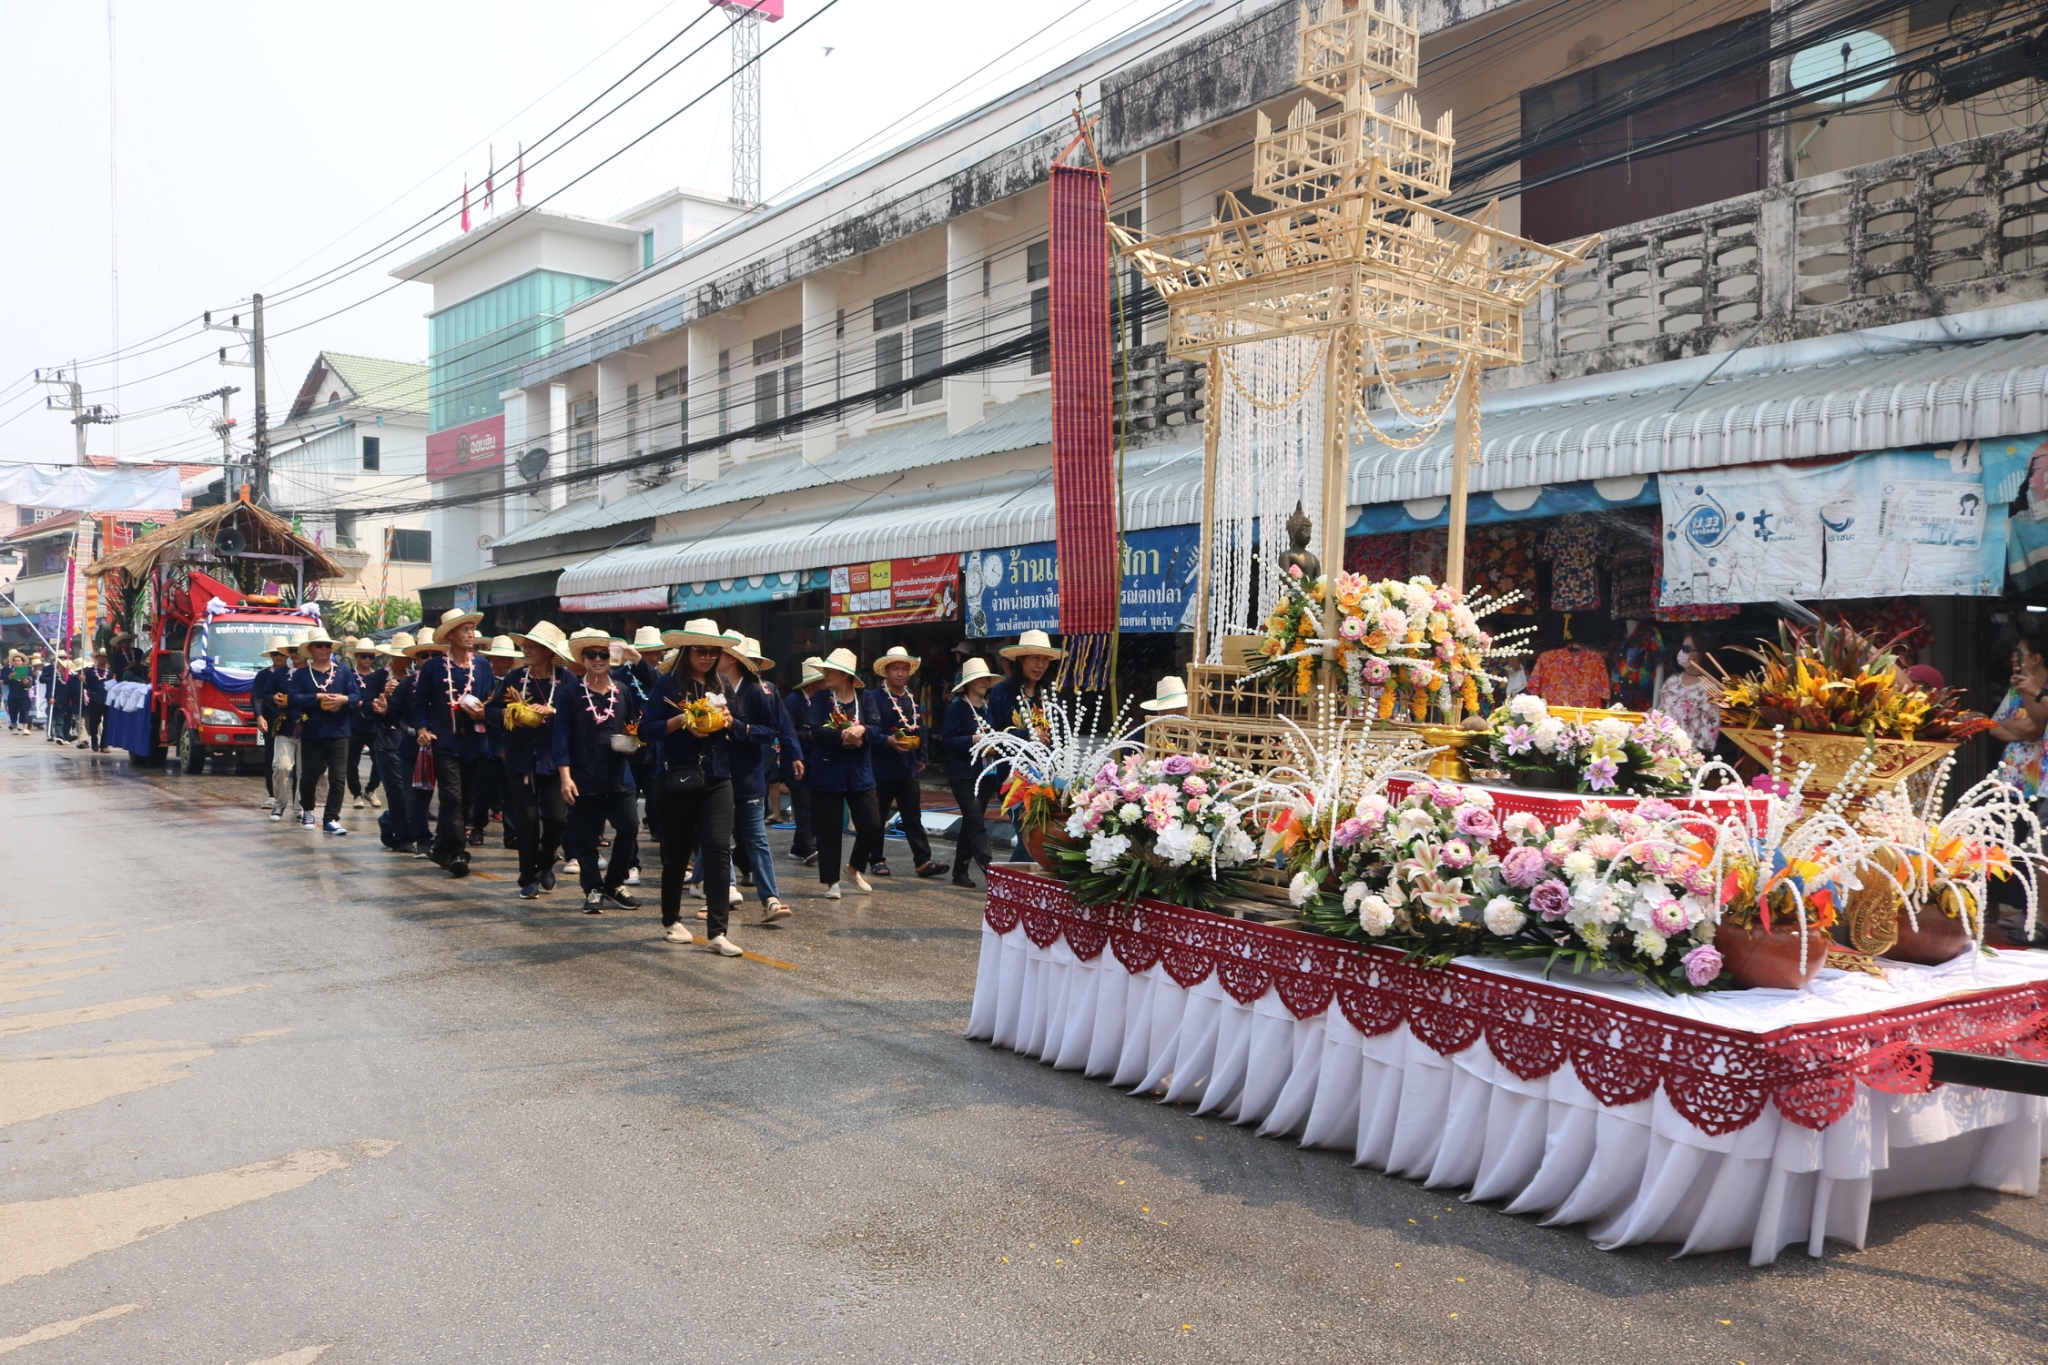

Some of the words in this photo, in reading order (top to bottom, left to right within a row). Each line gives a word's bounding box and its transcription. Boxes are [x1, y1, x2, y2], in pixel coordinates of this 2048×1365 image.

[470, 433, 496, 454] ออมสิน
[1953, 518, 1974, 526] 0000
[1759, 528, 1769, 536] 50
[1149, 611, 1174, 631] ทุกรุ่น
